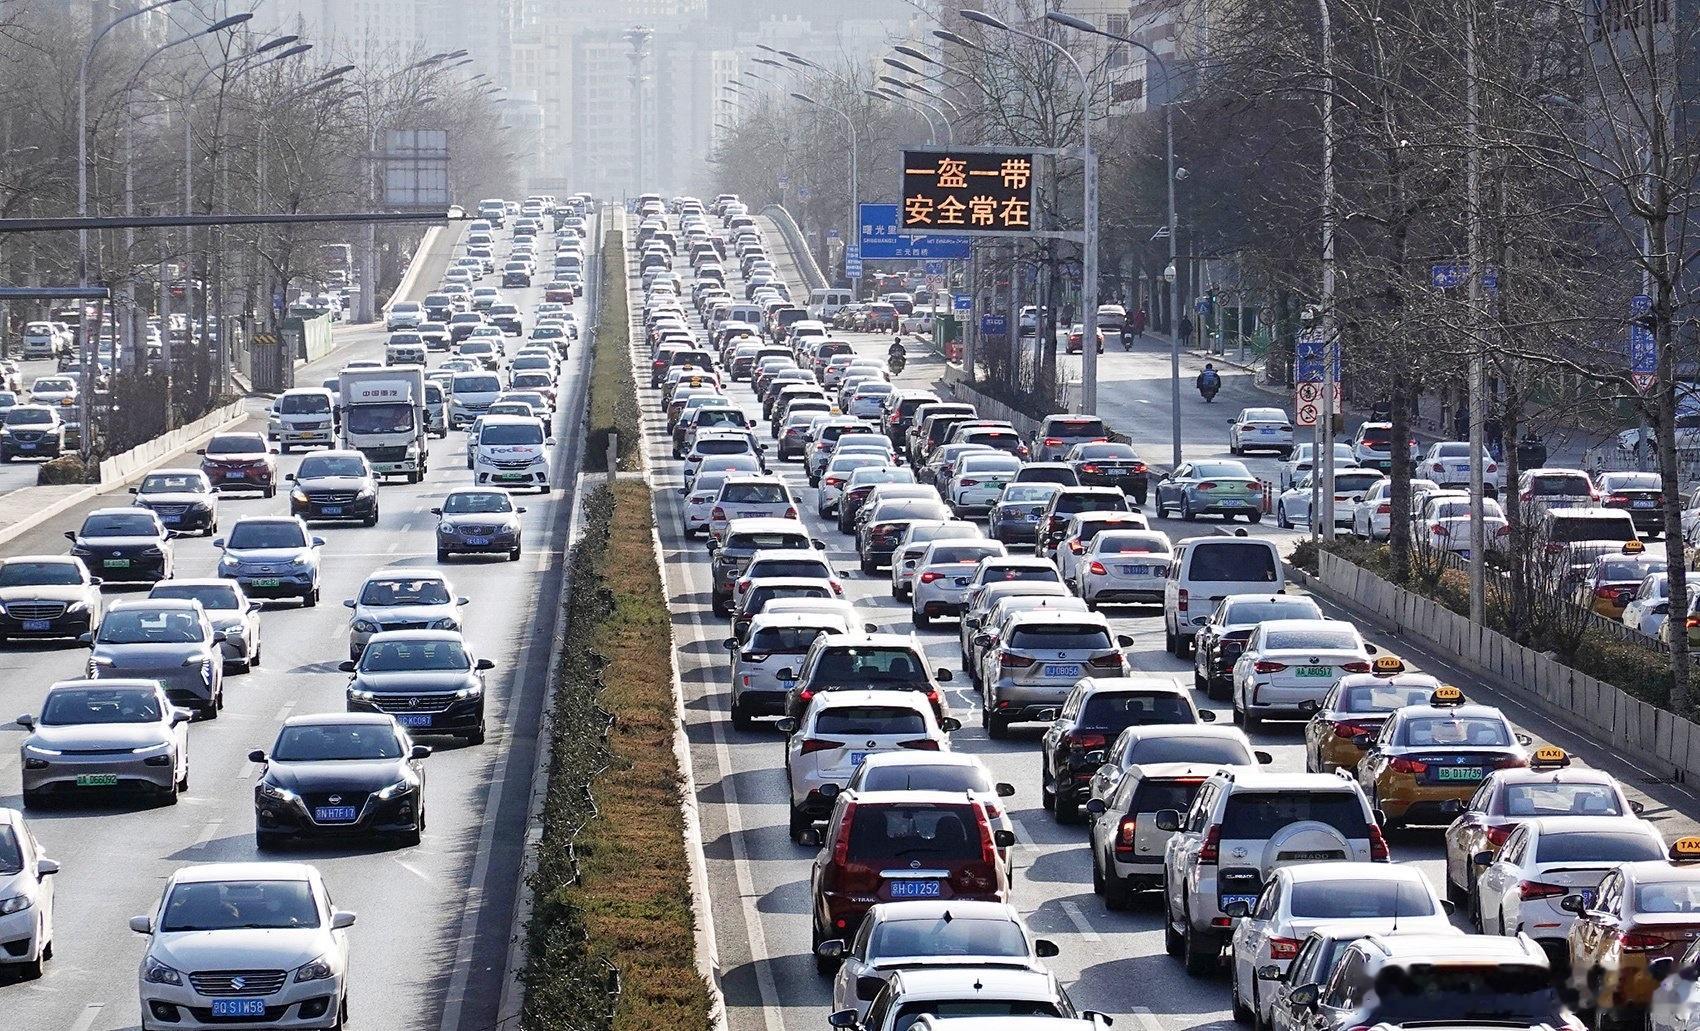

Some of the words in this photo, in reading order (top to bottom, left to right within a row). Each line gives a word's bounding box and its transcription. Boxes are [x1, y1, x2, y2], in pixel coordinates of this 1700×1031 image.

[905, 157, 1031, 190] 一盔一带
[905, 193, 1029, 226] 安全常在
[862, 225, 898, 235] 曙光里
[490, 446, 533, 454] FedEx
[1680, 841, 1700, 849] TAX
